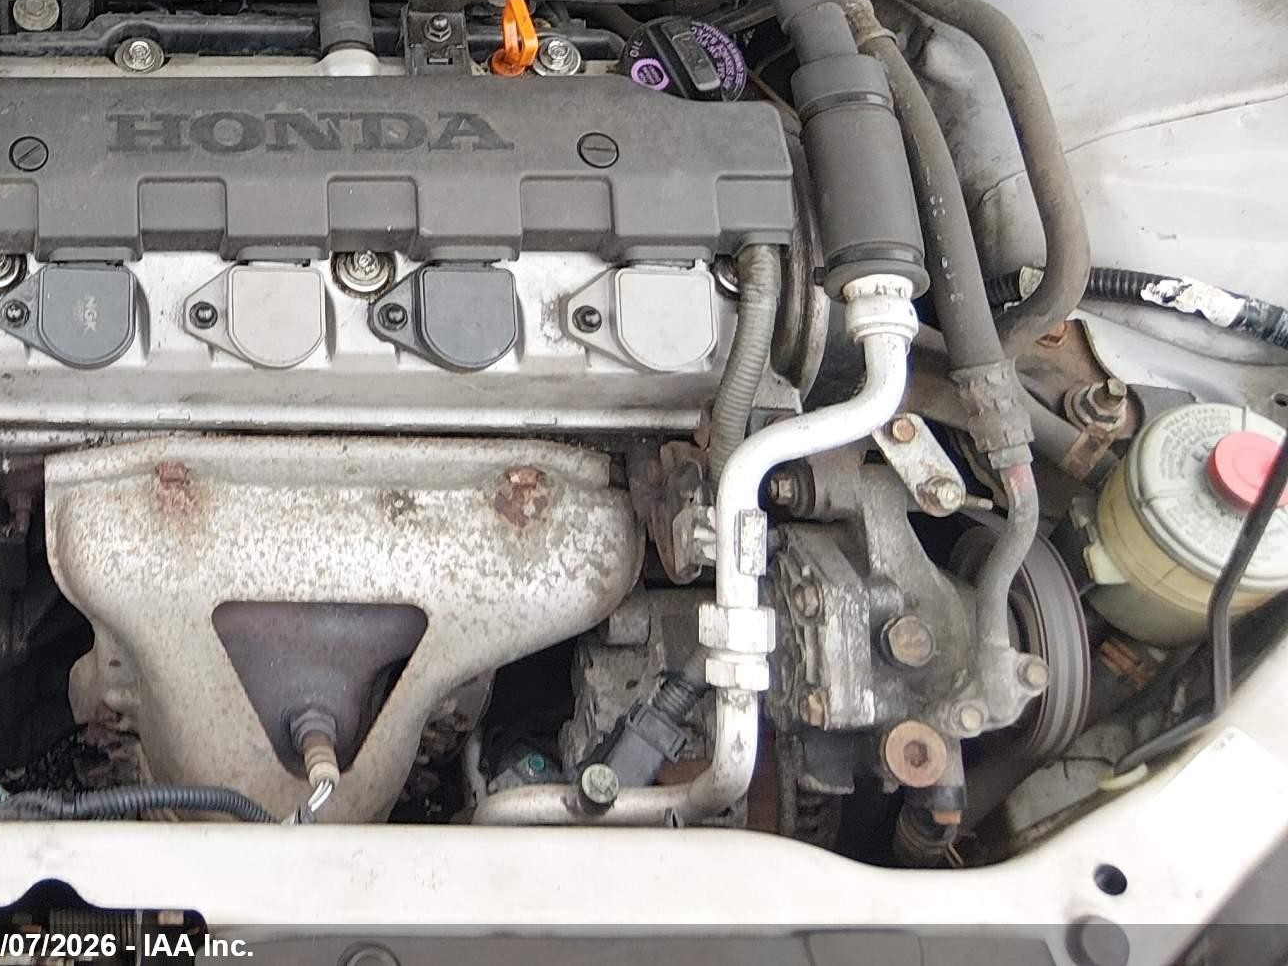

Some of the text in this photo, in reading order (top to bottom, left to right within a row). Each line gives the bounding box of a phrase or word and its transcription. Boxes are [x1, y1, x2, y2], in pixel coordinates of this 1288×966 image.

[629, 40, 644, 58] OIL
[105, 111, 515, 154] HONDA
[84, 296, 98, 332] NGK
